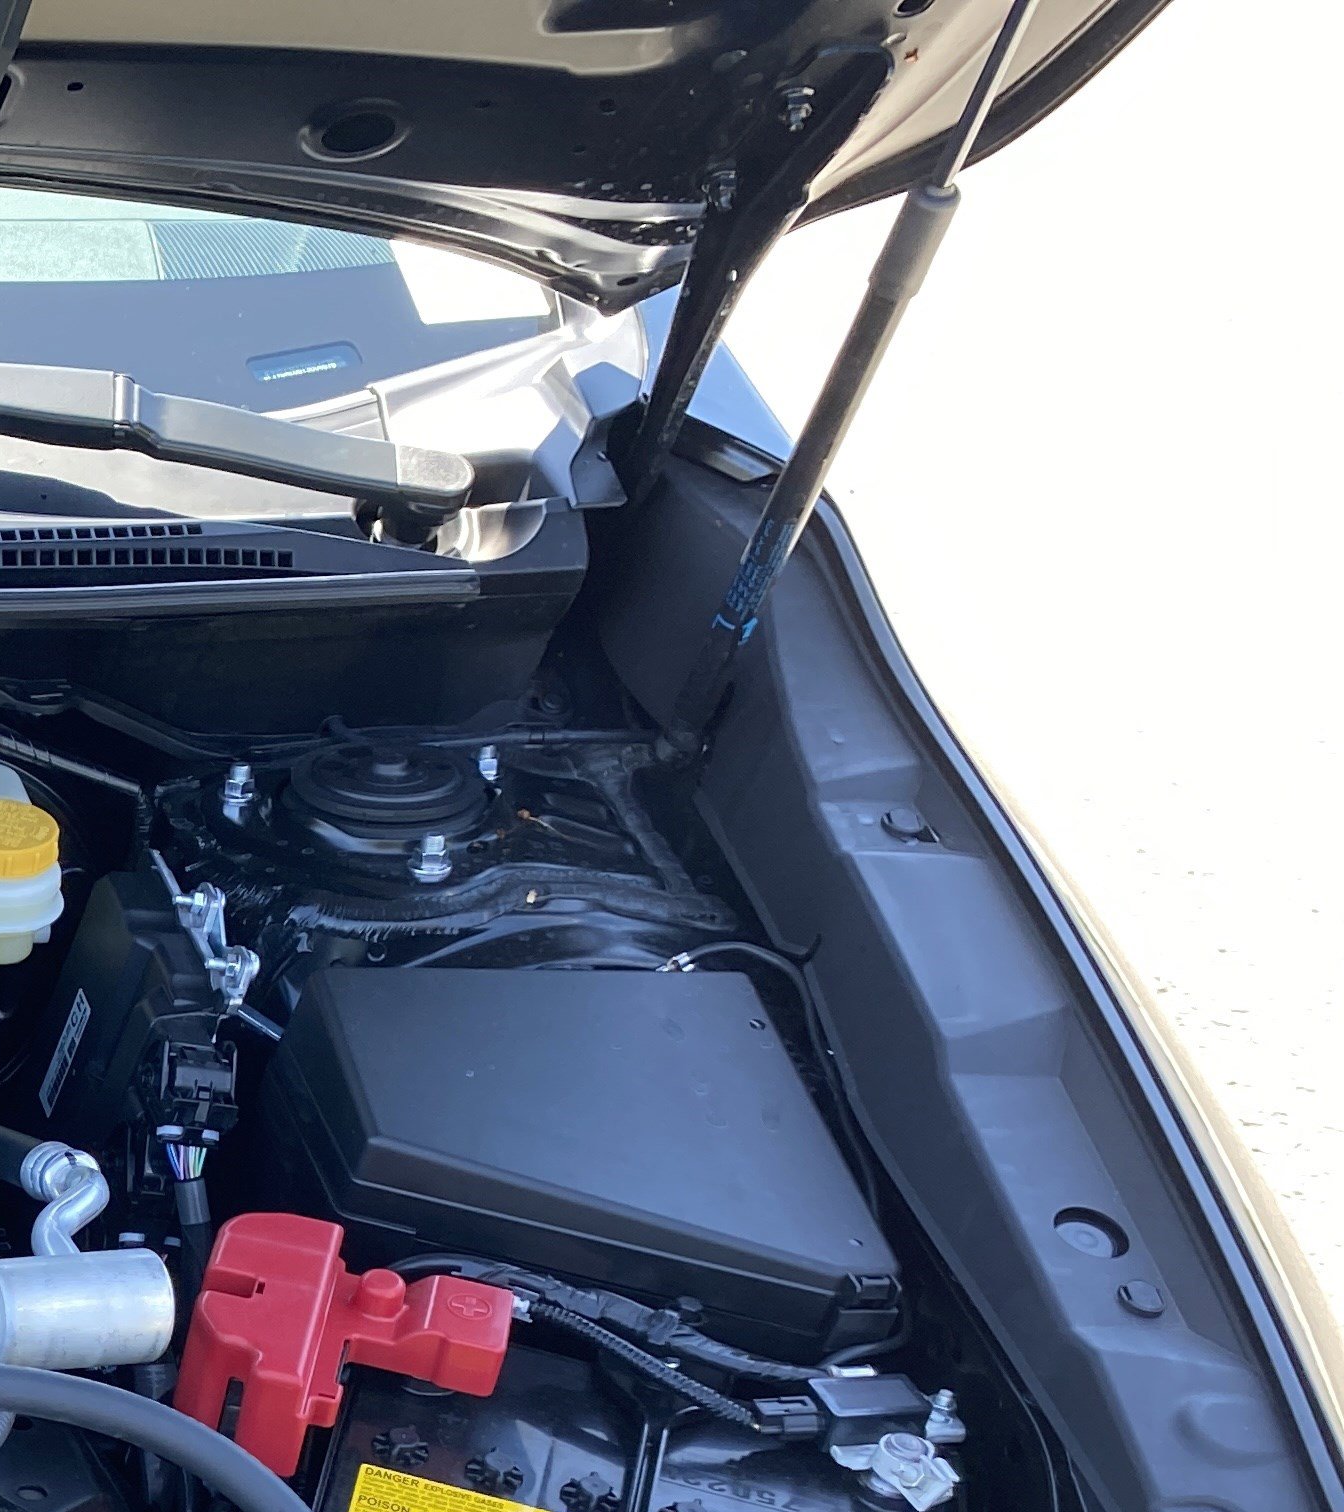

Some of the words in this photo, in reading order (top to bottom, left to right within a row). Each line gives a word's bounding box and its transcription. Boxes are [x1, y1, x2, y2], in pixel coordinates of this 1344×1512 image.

[365, 1467, 420, 1488] DANGER
[424, 1484, 472, 1501] EXPLOSIVE
[474, 1495, 504, 1509] GASES
